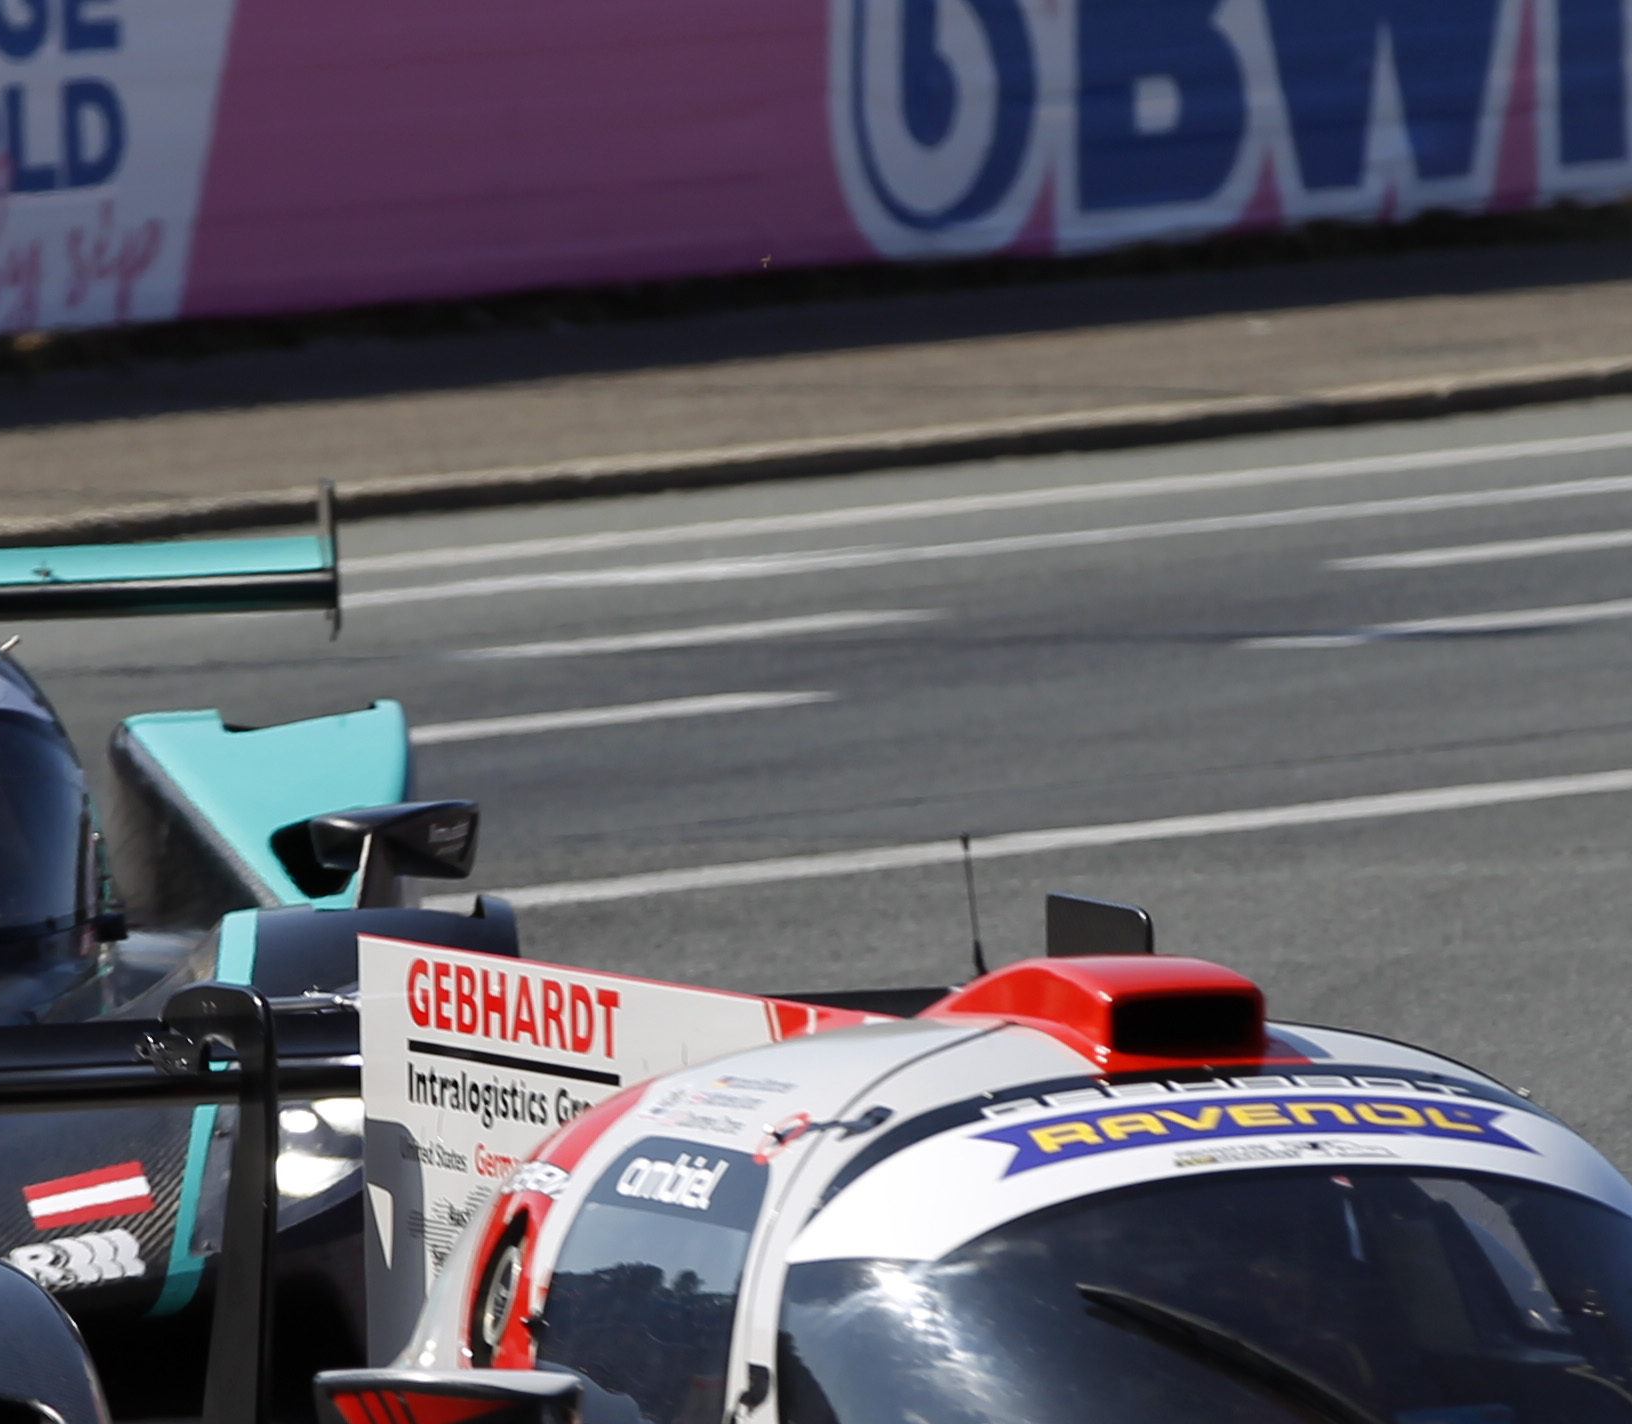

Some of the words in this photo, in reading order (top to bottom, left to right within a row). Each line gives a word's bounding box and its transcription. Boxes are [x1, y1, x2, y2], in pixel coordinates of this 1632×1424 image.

[407, 957, 621, 1060] GEBHARDT
[408, 1062, 548, 1129] Intralogistics
[1028, 1101, 1486, 1154] RAVENOL
